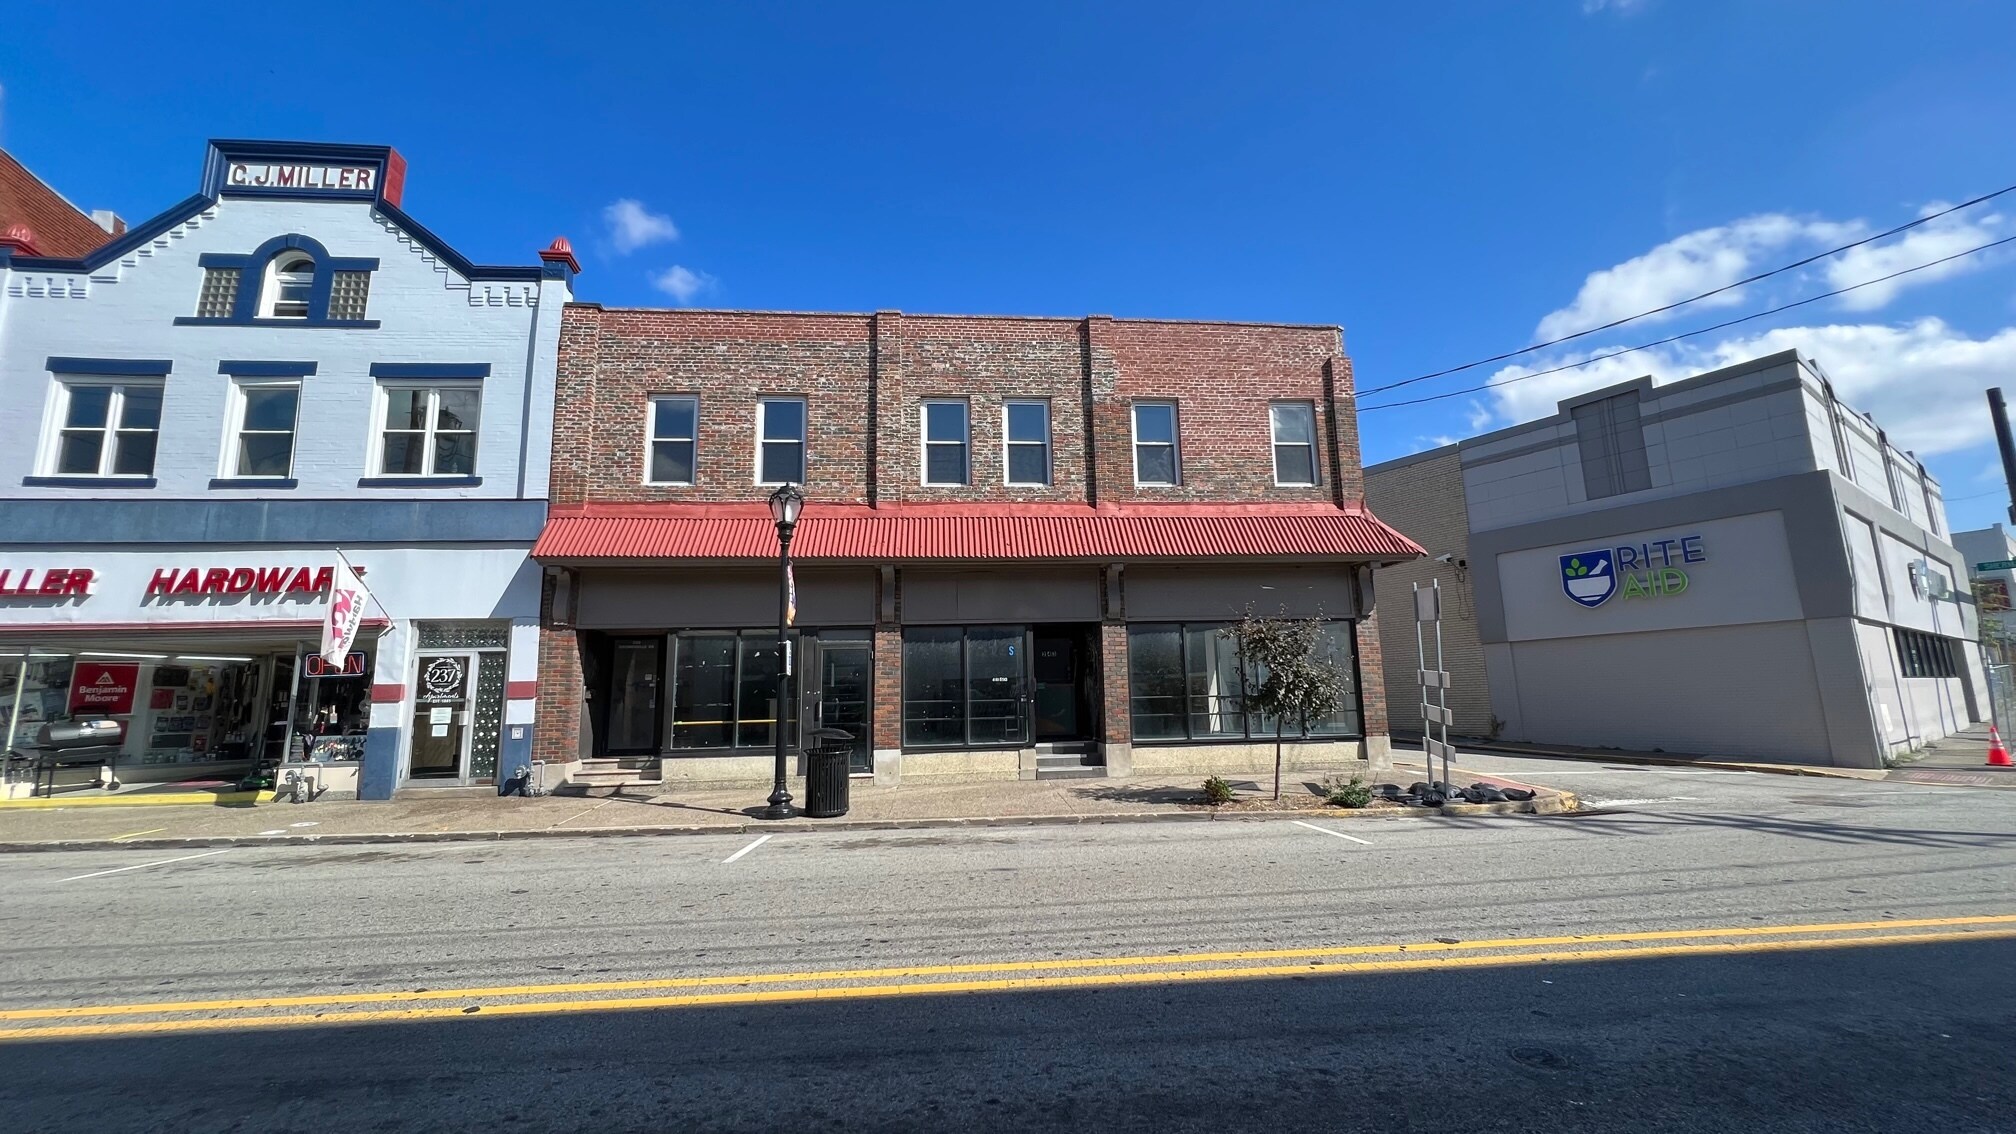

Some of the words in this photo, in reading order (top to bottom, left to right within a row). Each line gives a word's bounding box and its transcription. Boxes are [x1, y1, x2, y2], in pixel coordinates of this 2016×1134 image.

[1616, 535, 1707, 572] RITE
[147, 566, 366, 594] HARDWAR
[1622, 568, 1689, 600] AID
[430, 668, 457, 683] 237
[79, 685, 127, 695] Benjamin
[84, 694, 119, 702] Moore
